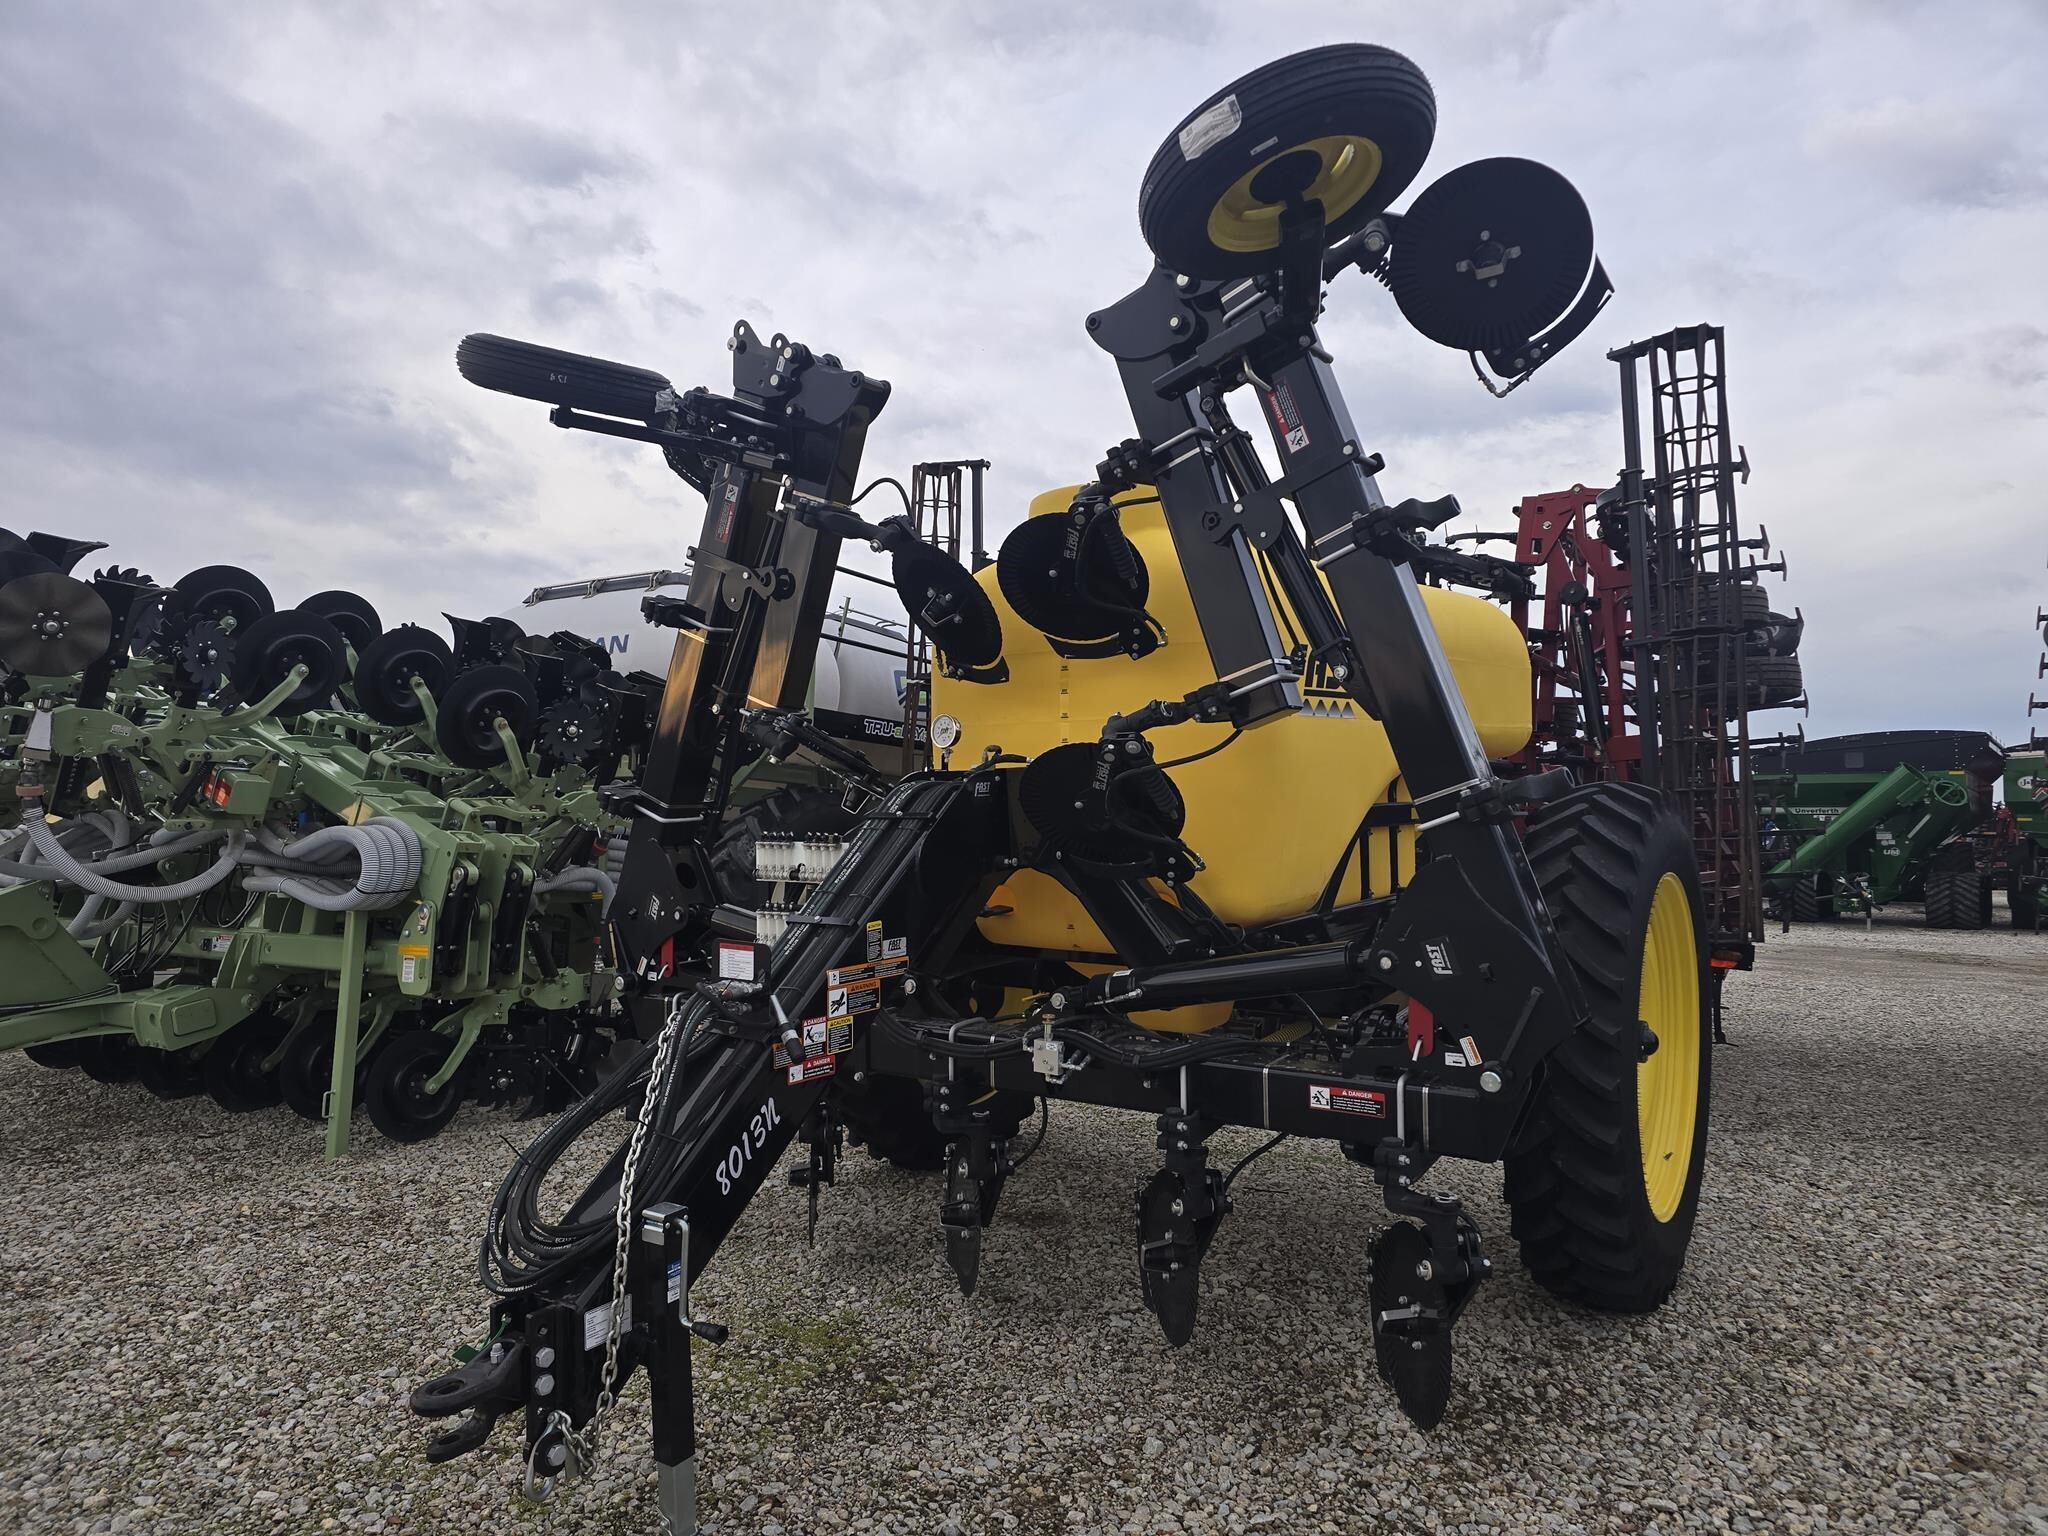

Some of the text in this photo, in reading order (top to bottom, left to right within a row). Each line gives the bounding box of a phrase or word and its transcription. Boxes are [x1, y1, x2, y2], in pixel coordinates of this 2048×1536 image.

[974, 782, 991, 797] FAST
[1425, 944, 1453, 975] FAST
[854, 981, 878, 990] WARNING
[808, 1016, 827, 1026] DANGER
[834, 1017, 852, 1027] CAUTION
[813, 1057, 831, 1067] DANGER
[1347, 1090, 1373, 1099] DANGER
